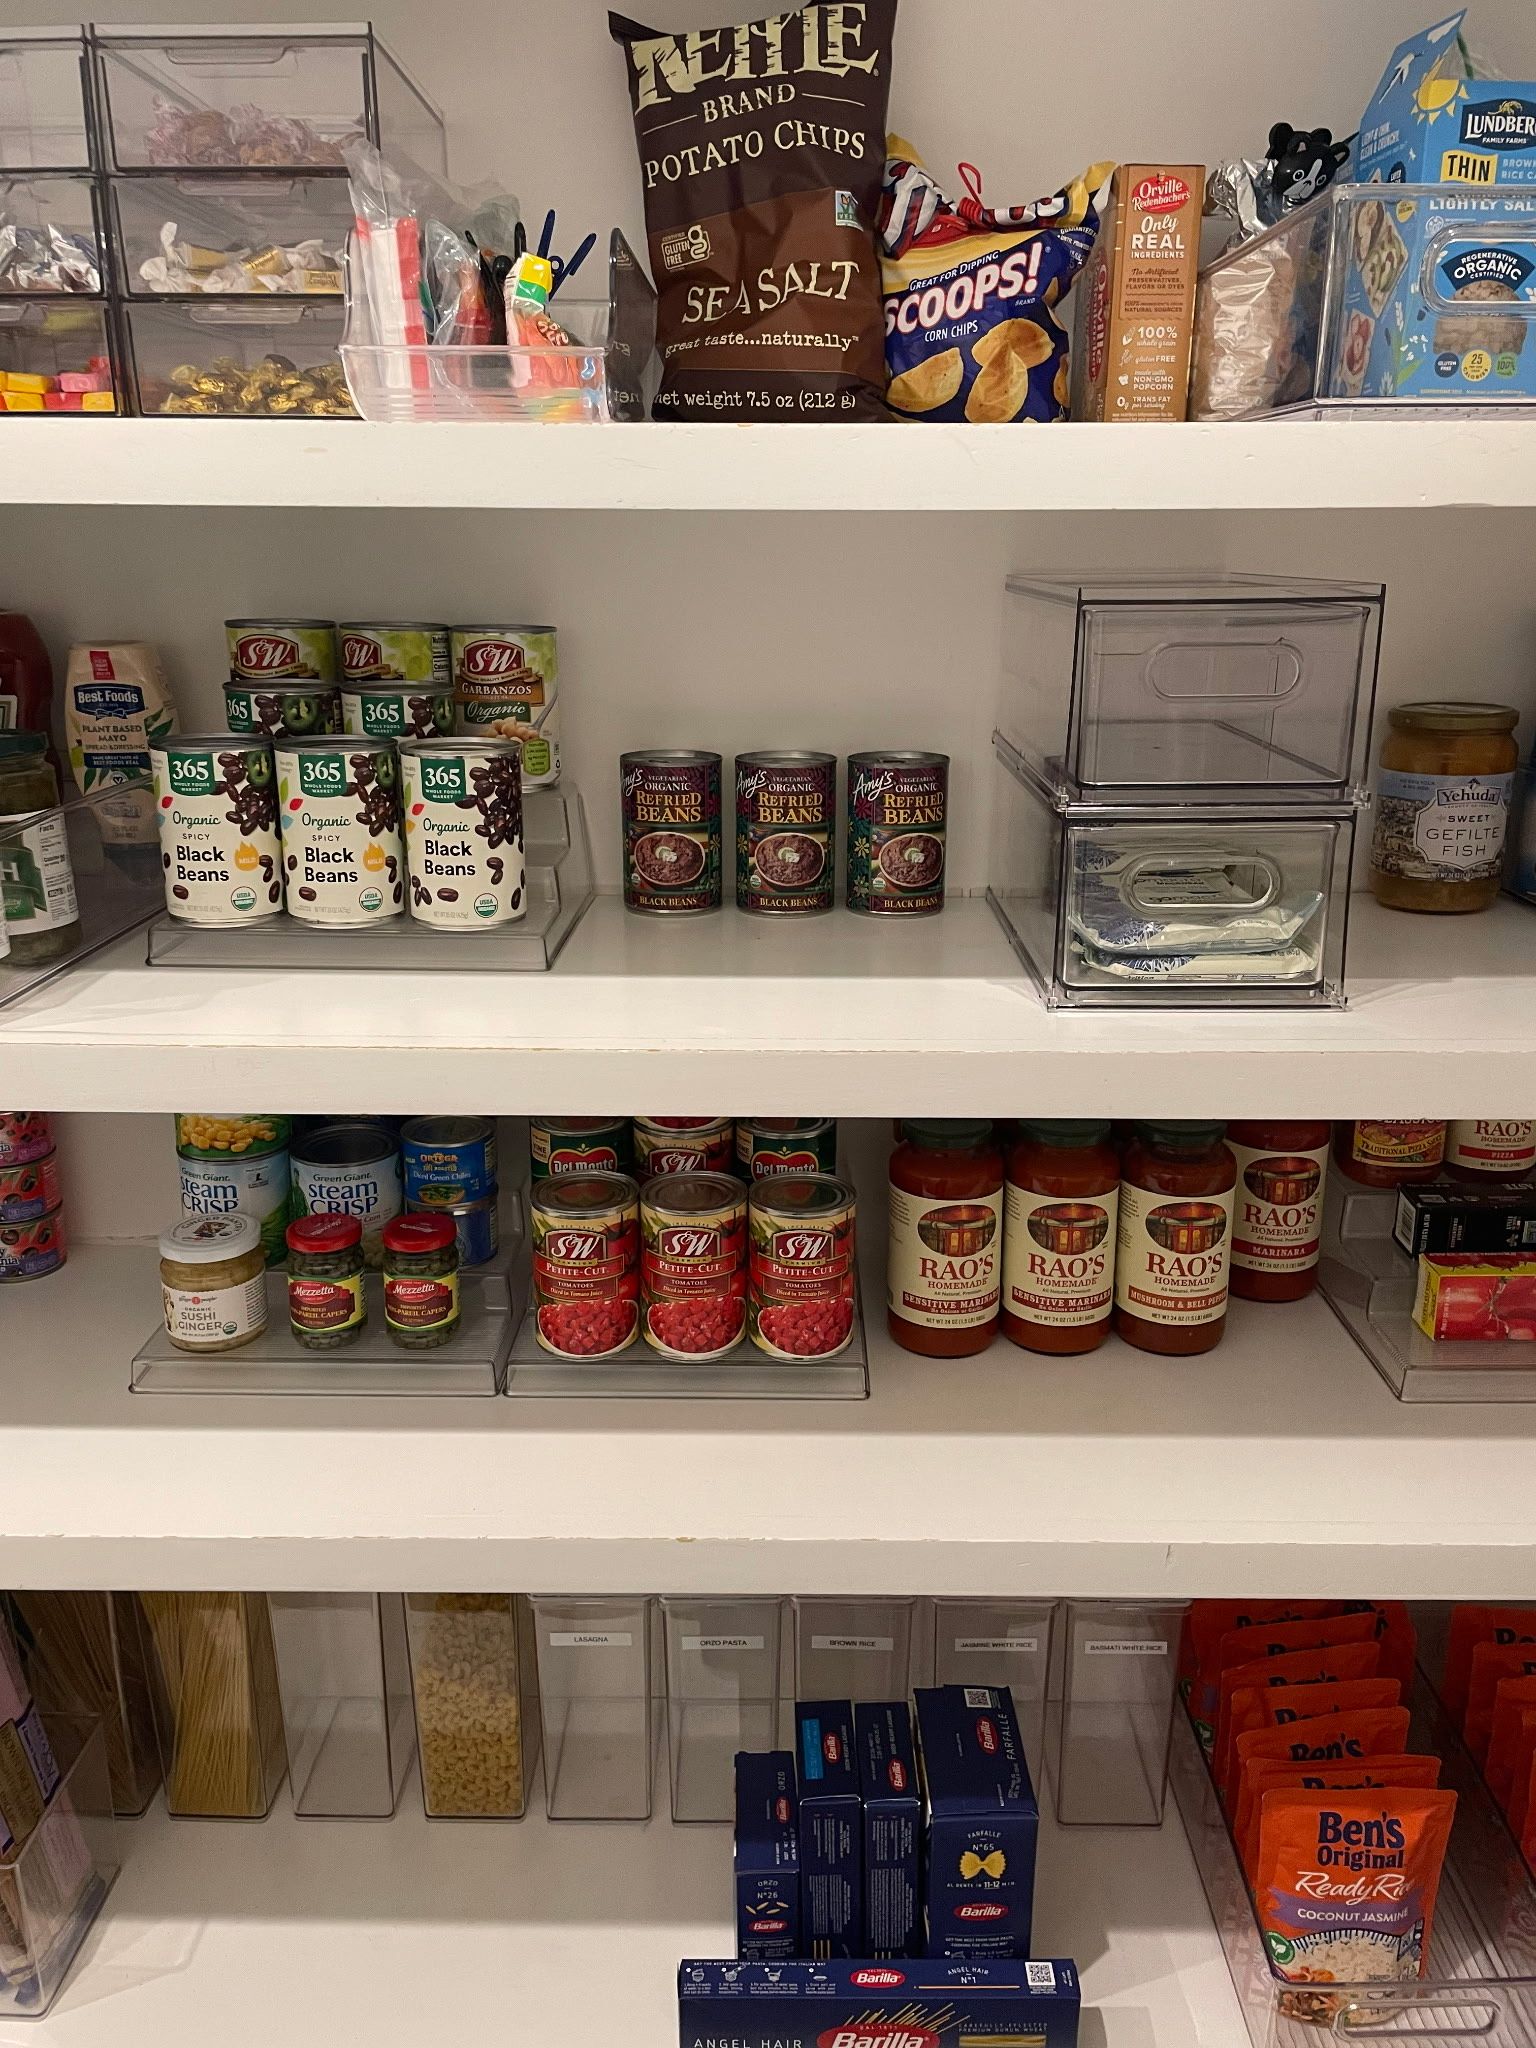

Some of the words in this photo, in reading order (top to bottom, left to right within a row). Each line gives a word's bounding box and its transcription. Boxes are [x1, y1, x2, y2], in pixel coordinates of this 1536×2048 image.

[702, 83, 796, 124] BRAND
[1465, 113, 1536, 140] LUNDBER
[1481, 136, 1505, 144] FAMILY
[1506, 137, 1527, 145] FARMS
[644, 130, 764, 189] POTATO
[774, 119, 866, 160] CHIPS
[1447, 153, 1492, 183] THIN
[1501, 171, 1525, 180] RICE
[1139, 179, 1184, 199] Orville
[1141, 214, 1179, 234] Only
[664, 240, 690, 255] GLUTEN
[1131, 233, 1185, 249] REAL
[667, 254, 683, 266] FREE
[1131, 251, 1185, 259] INGREDIENTS
[1461, 250, 1519, 265] REGENERATIVE
[909, 276, 938, 292] GREAT
[938, 267, 957, 284] FOR
[959, 250, 1000, 275] DIPPING
[1453, 259, 1523, 281] ORGANIC
[1469, 271, 1505, 280] CERTIFIED
[681, 279, 752, 325] SEA
[757, 260, 861, 312] SALT
[884, 241, 1044, 337] SCOOPS!
[924, 327, 949, 343] CORN
[951, 319, 979, 339] CHIPS
[1138, 326, 1178, 339] 100%
[664, 337, 701, 358] great
[1156, 355, 1176, 363] FREE
[1470, 353, 1484, 365] 25
[1133, 375, 1174, 383] NON-GMO
[1133, 383, 1174, 391] POPCORN
[684, 390, 743, 410] weight
[747, 391, 771, 407] 7.5
[775, 394, 794, 408] oz
[799, 389, 836, 412] (212
[841, 391, 857, 410] g)
[242, 639, 292, 668] S&W
[344, 640, 374, 667] S&W
[469, 644, 518, 673] S&W
[461, 681, 532, 696] GARBANZOS
[77, 690, 105, 705] Best
[105, 689, 140, 704] Foods
[227, 698, 249, 720] 365
[365, 702, 400, 723] 365
[466, 700, 527, 724] Organic
[82, 724, 111, 733] PLANT
[112, 724, 143, 733] BASED
[98, 734, 128, 743] MAYO
[172, 758, 210, 781] 365
[303, 760, 341, 782] 365
[424, 766, 461, 788] 365
[644, 782, 692, 792] ORGANIC
[768, 782, 816, 793] ORGANIC
[895, 782, 938, 794] ORGANIC
[635, 789, 702, 807] REFRIED
[758, 790, 824, 808] REFRIED
[883, 790, 945, 808] REFRIED
[1441, 788, 1498, 804] Yehuda
[172, 810, 222, 830] Organic
[301, 812, 352, 831] Organic
[636, 805, 702, 824] BEANS
[758, 806, 824, 825] BEANS
[883, 805, 944, 826] BEANS
[1447, 814, 1491, 824] SWEET
[423, 817, 471, 836] Organic
[1426, 826, 1501, 841] GEFILTE
[182, 832, 211, 842] SPICY
[311, 834, 341, 842] SPICY
[176, 844, 226, 862] Black
[304, 846, 355, 863] Black
[424, 839, 473, 857] Black
[1442, 844, 1487, 857] FISH
[176, 864, 230, 882] Beans
[304, 866, 359, 883] Beans
[424, 859, 476, 876] Beans
[479, 898, 493, 906] USDA
[639, 895, 668, 907] BLACK
[669, 896, 698, 907] BEANS
[760, 897, 788, 908] BLACK
[790, 897, 818, 908] BEANS
[883, 899, 913, 909] BLACK
[915, 897, 938, 909] BEANS
[1474, 1119, 1533, 1138] RAO'S
[419, 1153, 459, 1165] ORTEGA
[654, 1151, 702, 1174] S&W
[1490, 1151, 1515, 1160] PIZZA
[553, 1160, 573, 1173] Del
[575, 1158, 615, 1172] Monte
[755, 1161, 774, 1176] Del
[202, 1173, 230, 1182] Giant
[313, 1173, 342, 1183] Green
[343, 1171, 370, 1182] Giant
[429, 1173, 450, 1182] Green
[308, 1180, 378, 1200] steam
[182, 1192, 239, 1214] CRISP
[310, 1196, 378, 1216] CRISP
[1242, 1202, 1317, 1228] RAO'S
[1250, 1225, 1310, 1237] HOMEMADE
[550, 1233, 600, 1259] S&W
[664, 1230, 715, 1256] S&W
[778, 1233, 830, 1259] S&W
[1252, 1245, 1306, 1257] MARINARA
[546, 1262, 607, 1277] PETITE-CUT
[658, 1260, 721, 1273] PETITE-CUT
[771, 1263, 834, 1277] PETITE-CUT
[918, 1252, 995, 1281] RAO'S
[1027, 1251, 1106, 1279] RAO'S
[1145, 1251, 1223, 1278] RAO'S
[392, 1283, 436, 1296] Mezzetta
[557, 1281, 594, 1289] TOMATOES
[927, 1277, 988, 1290] HOMEMADE
[1035, 1276, 1098, 1288] HOMEMADE
[1154, 1275, 1216, 1288] HOMEMADE
[293, 1285, 335, 1297] Mezzetta
[1013, 1288, 1065, 1307] SENSITIVE
[1130, 1289, 1176, 1309] MUSHROOM
[1177, 1299, 1184, 1309] &
[1186, 1297, 1206, 1309] BELL
[904, 1293, 957, 1310] SENSITIVE
[180, 1311, 217, 1321] SUSHI
[178, 1321, 224, 1332] GINGER
[573, 1636, 609, 1645] LASAGNA
[699, 1639, 721, 1648] ORZO
[722, 1639, 748, 1648] PASTA
[828, 1639, 858, 1648] BROWN
[858, 1640, 877, 1648] RICE
[991, 1641, 1015, 1650] WHITE
[1015, 1642, 1034, 1650] RICE
[981, 1720, 995, 1751] Barilla
[996, 1712, 1018, 1761] FARFALLE
[827, 1734, 839, 1760] Barilla
[777, 1770, 787, 1792] ORZO
[891, 1762, 904, 1788] Barilla
[967, 1830, 1002, 1840] FARFALLE
[1317, 1810, 1406, 1850] Ben's
[1316, 1845, 1405, 1872] Original
[756, 1879, 780, 1888] ORZO
[983, 1880, 1001, 1889] 11-12
[1295, 1870, 1372, 1906] Ready
[960, 1905, 1003, 1918] Barilla
[1297, 1907, 1360, 1922] COCONUT
[1362, 1906, 1409, 1923] JASMINE
[752, 1920, 785, 1931] Barilla
[856, 1973, 900, 1984] Barilla
[947, 1967, 970, 1976] ANGEL
[972, 1967, 990, 1976] HAIR
[694, 2038, 751, 2048] ANGEL
[760, 2038, 802, 2048] HAIR
[832, 2032, 924, 2048] Barilla
